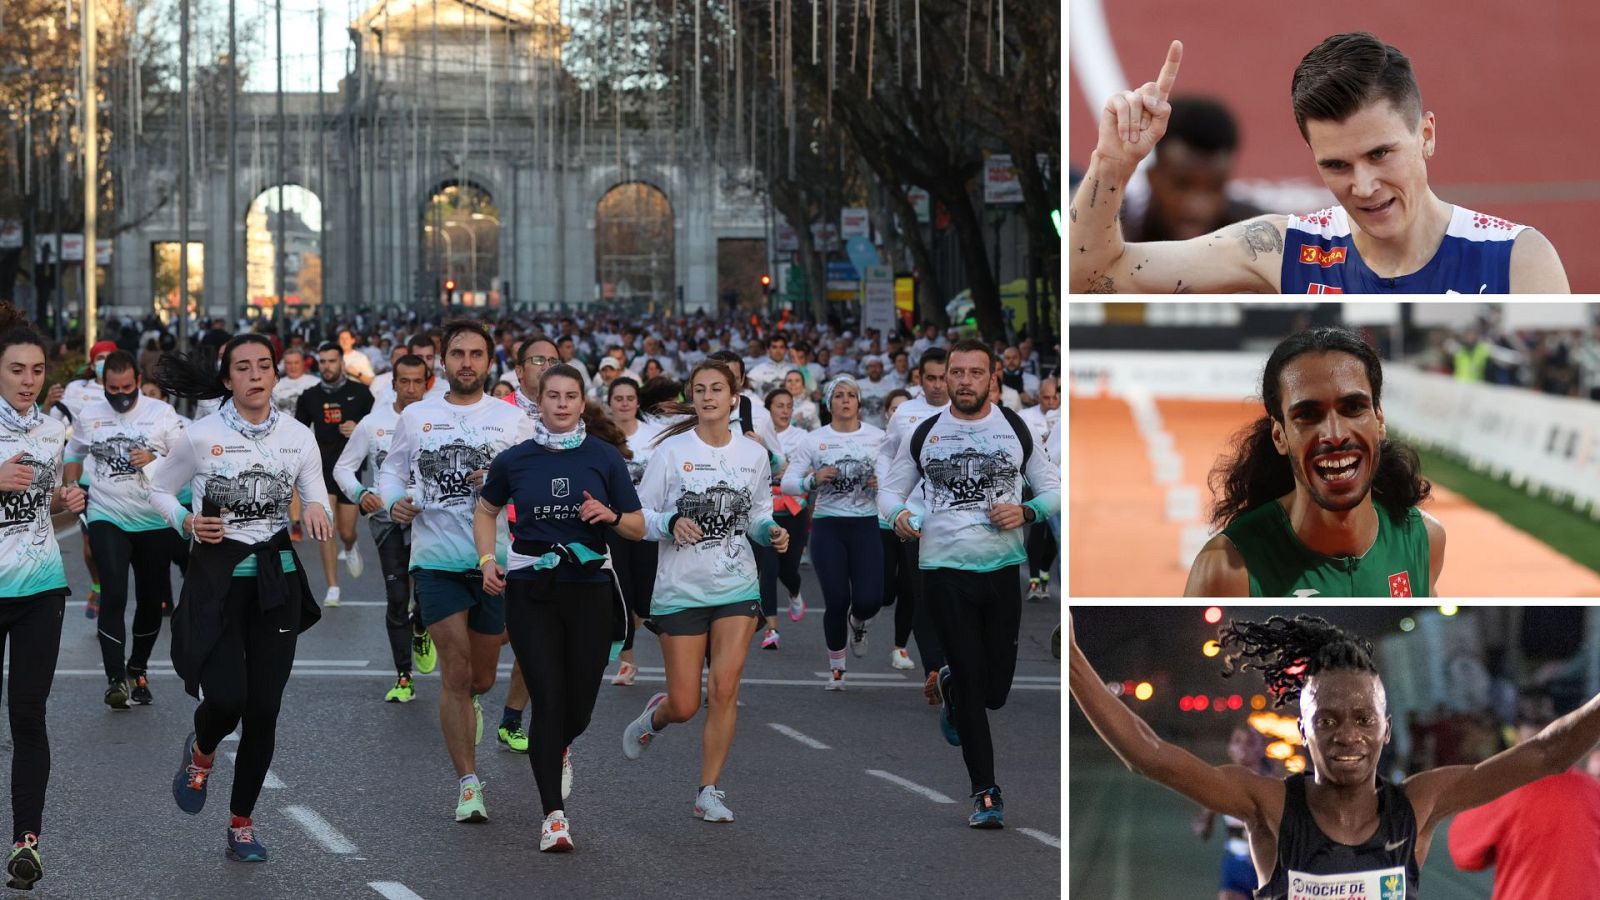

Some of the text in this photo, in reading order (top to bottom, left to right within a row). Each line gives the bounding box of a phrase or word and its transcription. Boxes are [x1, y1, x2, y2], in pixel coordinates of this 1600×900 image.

[279, 447, 302, 455] OYSHO
[438, 482, 473, 497] MOS
[952, 487, 986, 501] MOS
[4, 505, 37, 521] MOS
[534, 503, 581, 514] ESPAÑ
[1305, 883, 1365, 896] NOCHE DE
